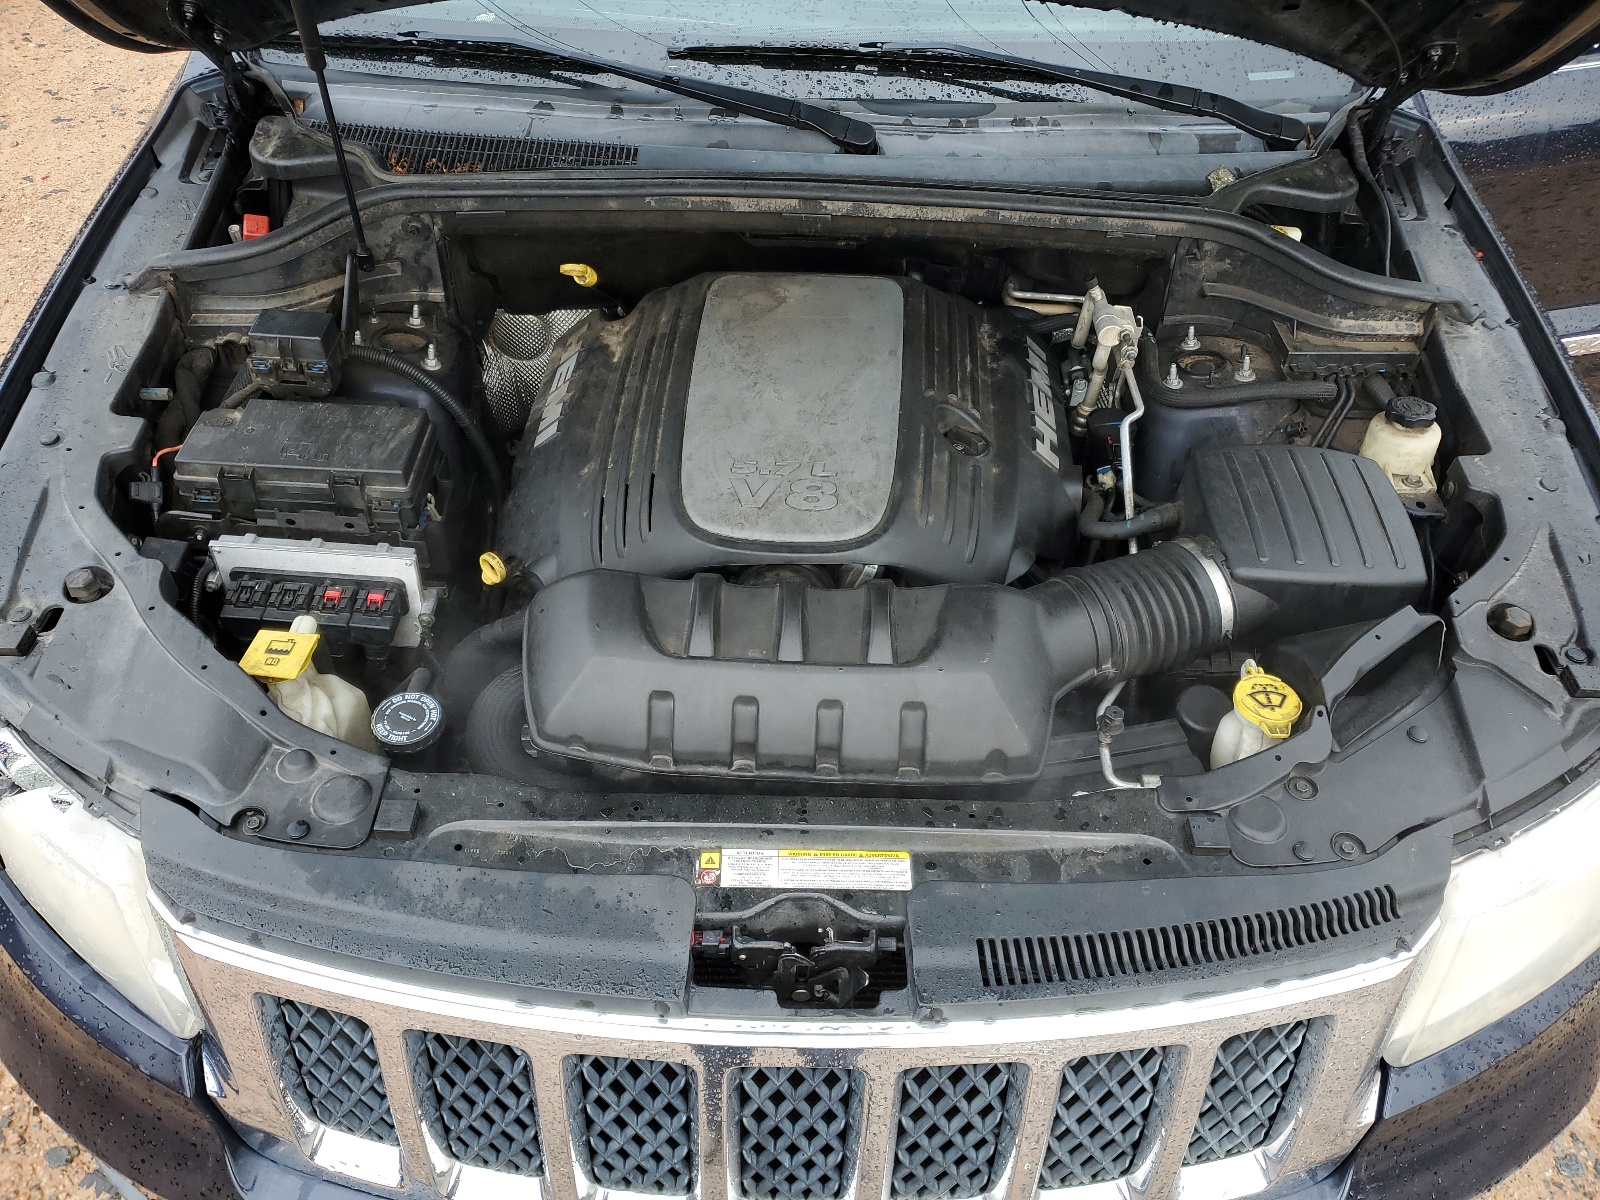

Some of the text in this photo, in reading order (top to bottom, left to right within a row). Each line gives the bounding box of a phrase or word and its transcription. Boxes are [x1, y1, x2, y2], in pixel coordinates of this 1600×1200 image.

[1026, 336, 1060, 469] HEMI
[728, 476, 839, 512] V8
[391, 695, 403, 704] DO
[420, 696, 436, 709] OPEN
[429, 709, 438, 721] HOT
[375, 723, 388, 736] KEEP
